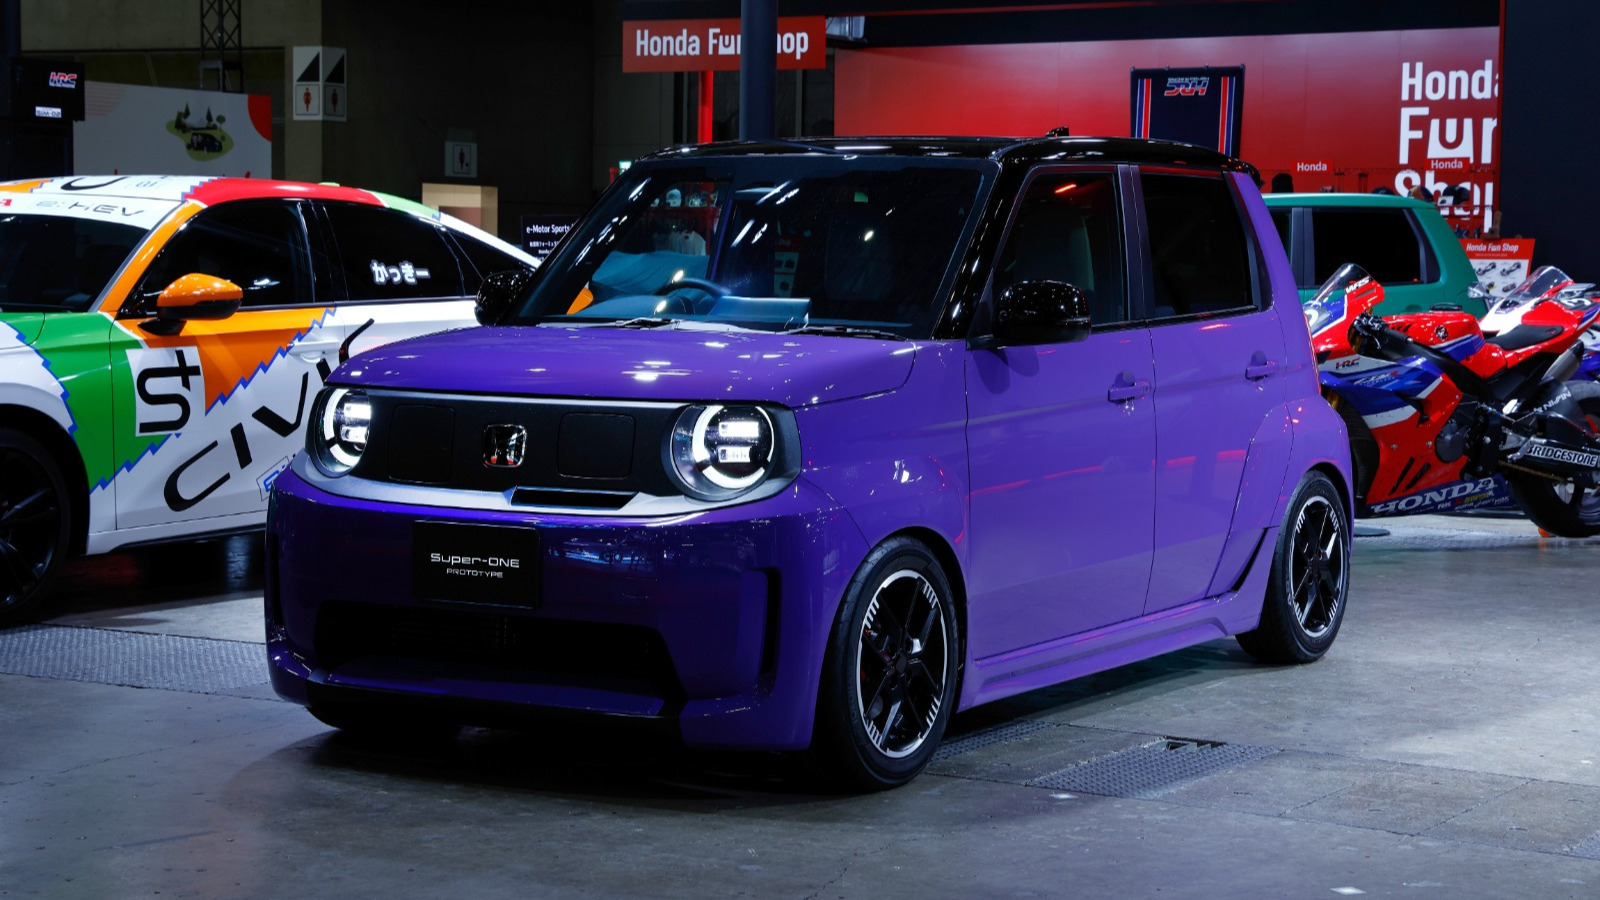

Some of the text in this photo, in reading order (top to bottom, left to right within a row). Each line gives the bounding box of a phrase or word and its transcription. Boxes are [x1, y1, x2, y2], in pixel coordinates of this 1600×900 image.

[636, 28, 809, 60] Honda Fu op
[49, 72, 77, 87] HRC
[1401, 60, 1499, 101] Hond
[1297, 161, 1327, 171] Honda
[1431, 159, 1463, 169] Honda
[526, 225, 550, 234] e-Motor
[551, 224, 570, 235] Sports
[1466, 243, 1519, 253] Honda Fun Shop
[370, 260, 430, 285] かっきー
[1335, 357, 1361, 370] HRC
[1526, 443, 1598, 467] BRIDGESTONE
[1370, 477, 1498, 514] HONDA
[430, 552, 520, 568] Super-ONE
[446, 568, 503, 579] PROTOTYPE
